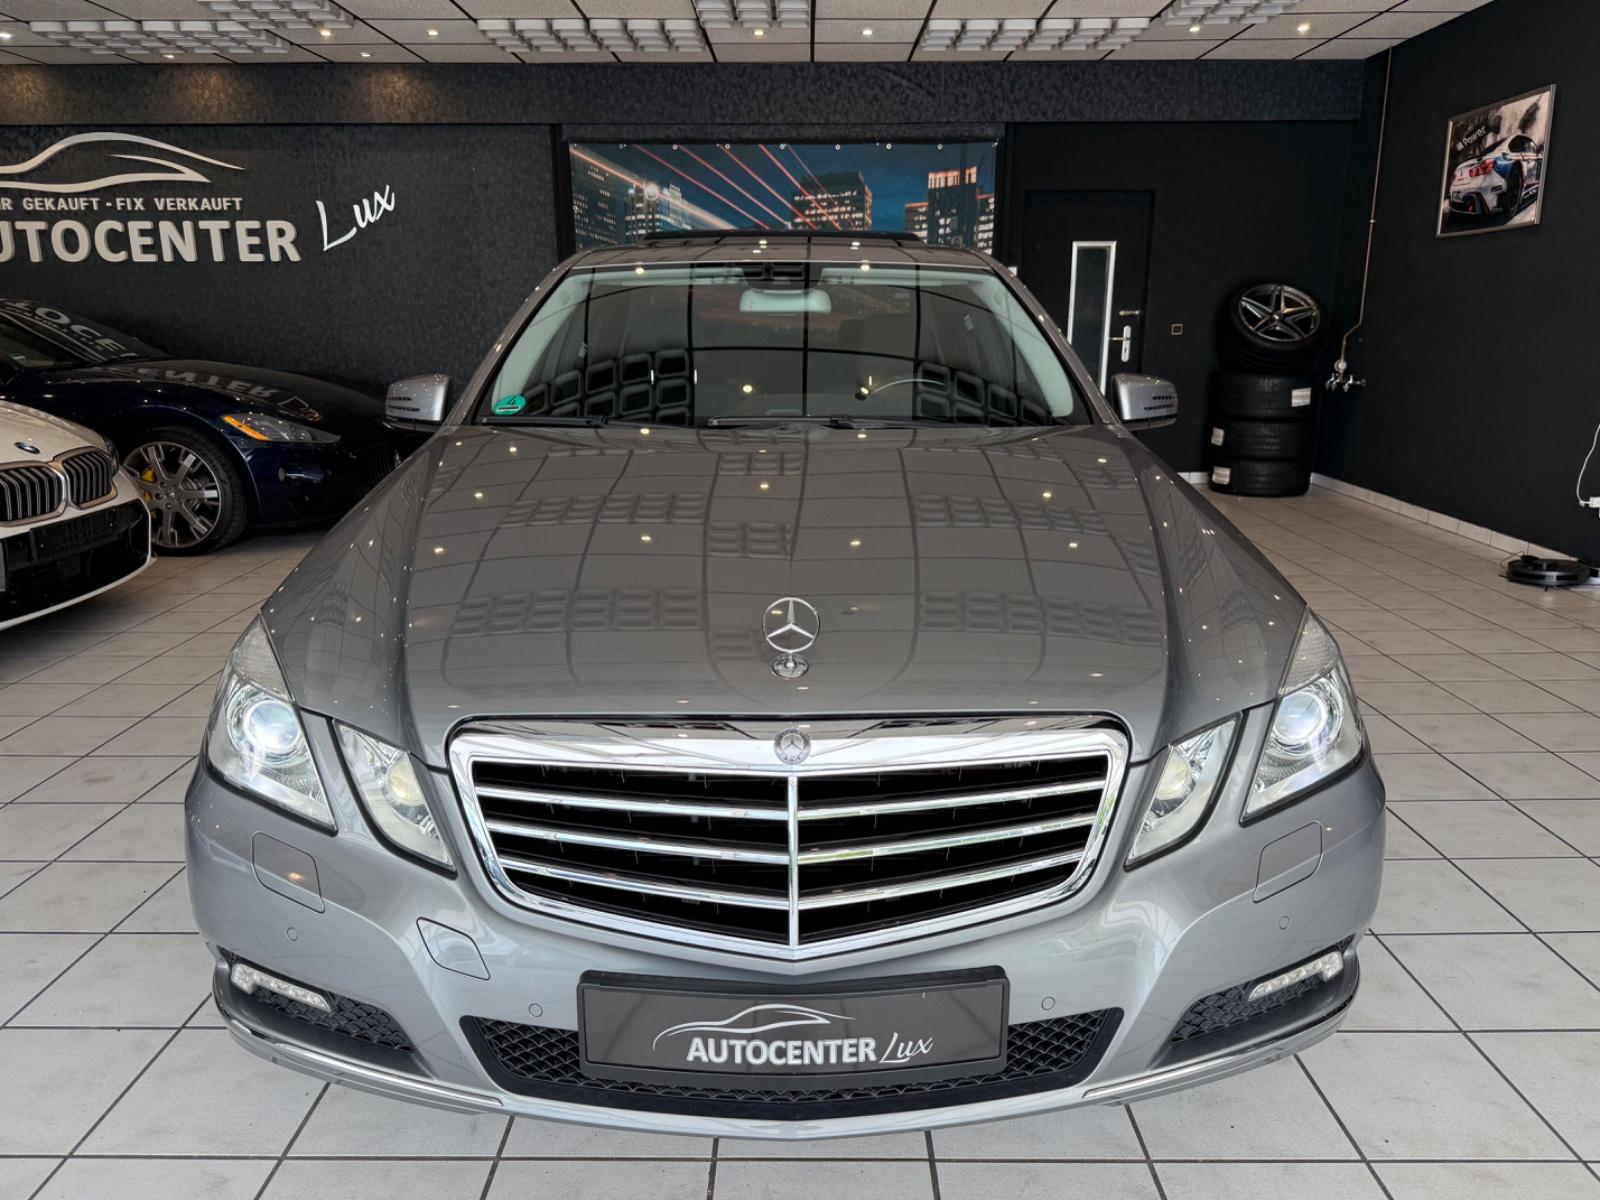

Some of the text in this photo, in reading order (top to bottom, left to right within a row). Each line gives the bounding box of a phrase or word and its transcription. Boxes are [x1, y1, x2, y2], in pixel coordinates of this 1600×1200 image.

[22, 197, 100, 211] GEKAUFT
[116, 198, 146, 211] FIX
[154, 197, 243, 211] VERKAUFT
[316, 184, 395, 252] Lux
[686, 1032, 934, 1065] AUTOCENTER Lux
